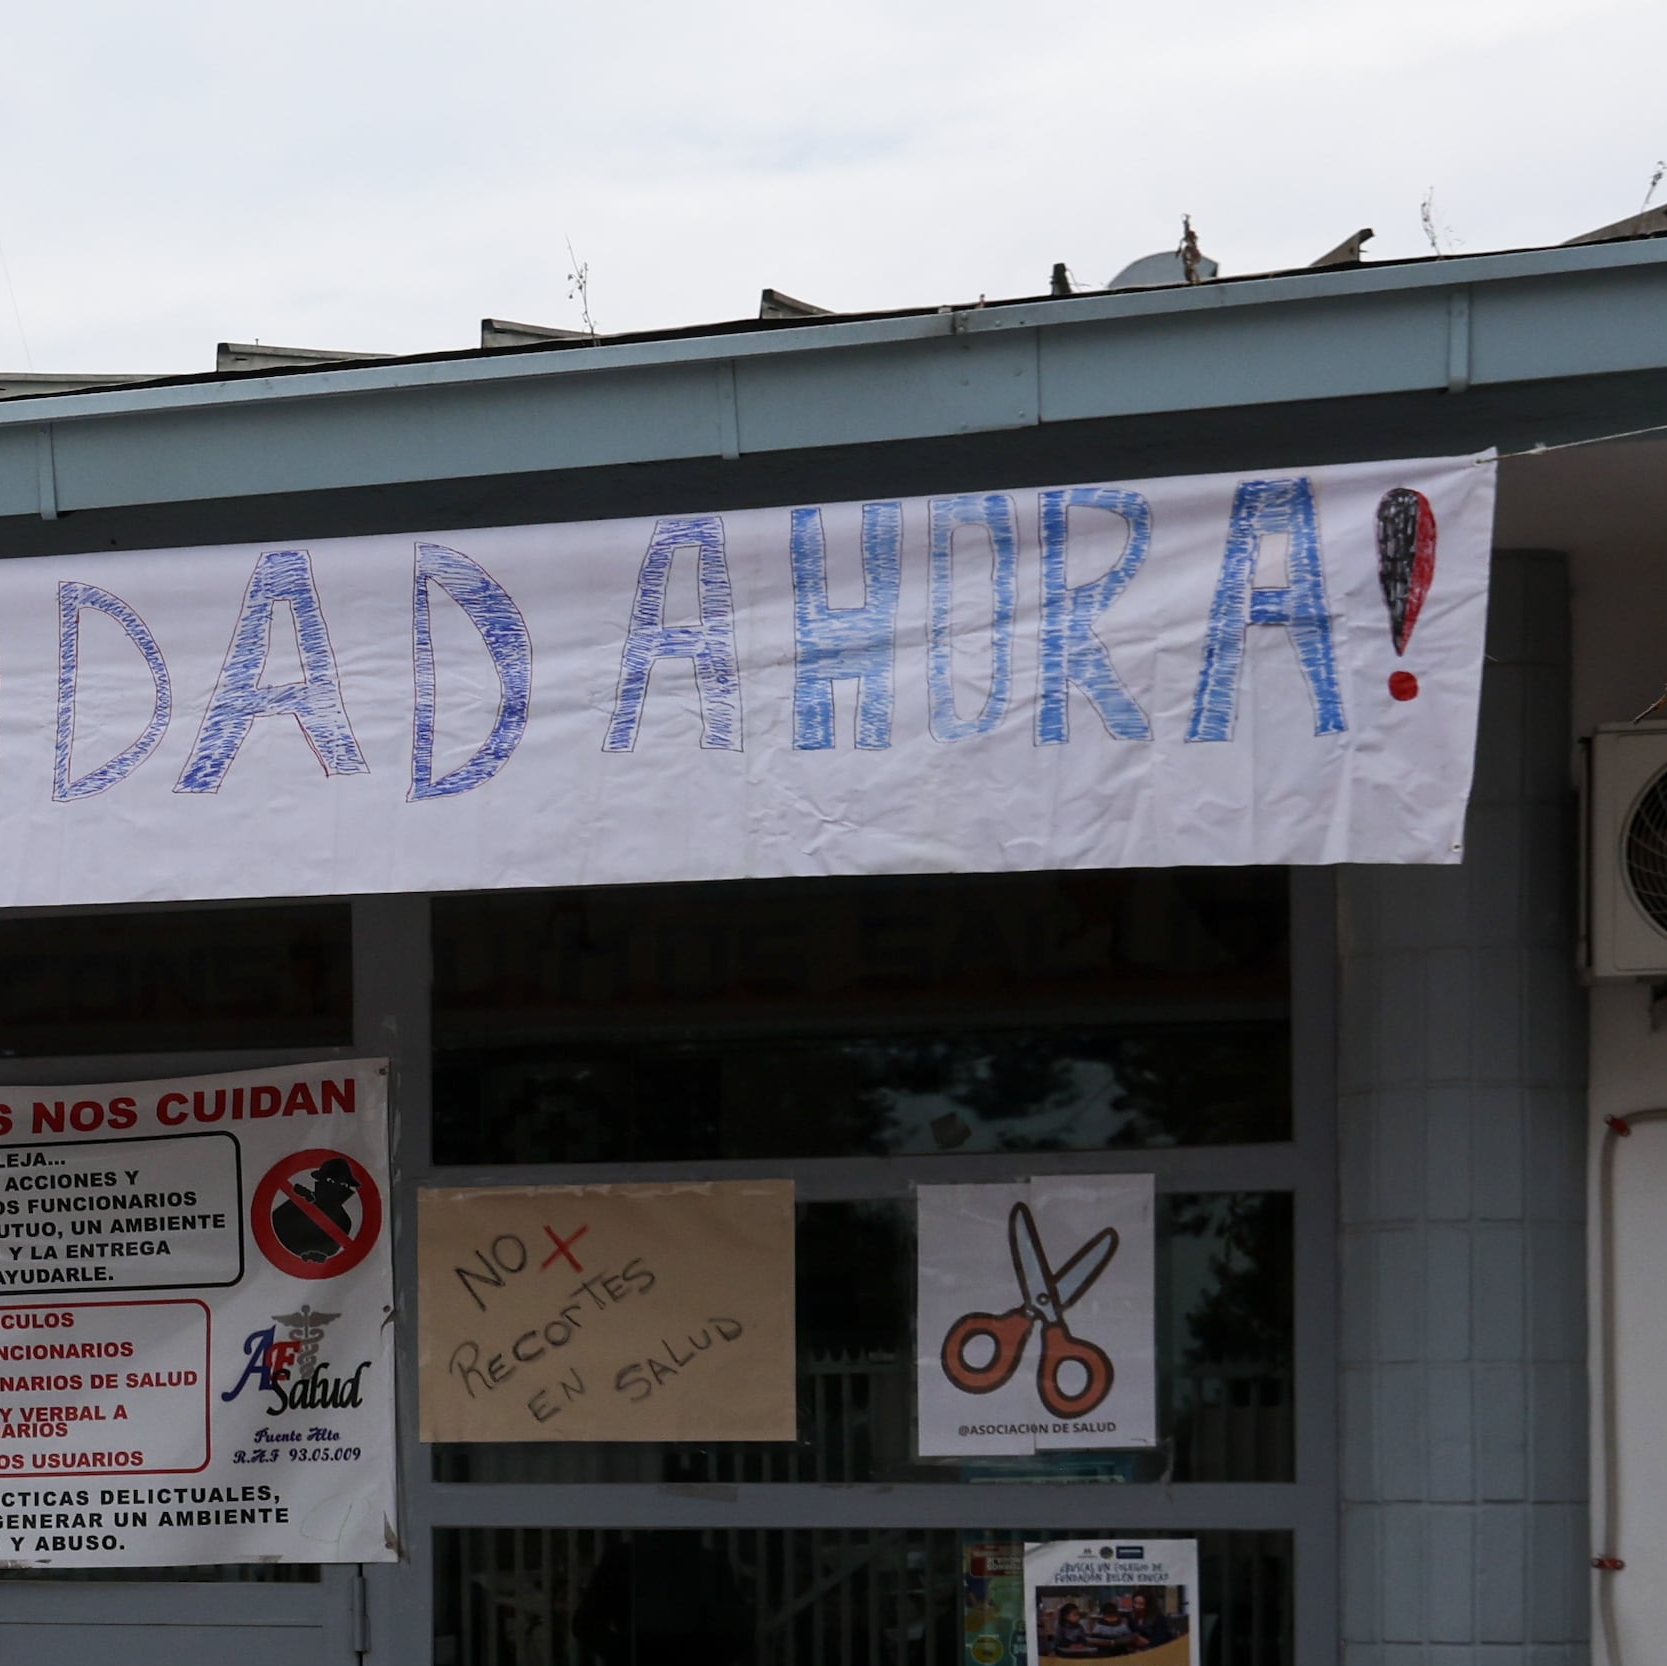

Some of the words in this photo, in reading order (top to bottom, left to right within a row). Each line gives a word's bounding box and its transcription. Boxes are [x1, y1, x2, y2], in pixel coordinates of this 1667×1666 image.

[31, 1097, 138, 1134] NOS
[156, 1078, 356, 1126] CUIDAN
[4, 1171, 117, 1192] ACCIONES
[124, 1170, 139, 1186] Y
[27, 1191, 197, 1214] FUNCIONARIOS
[70, 1219, 102, 1236] UN
[109, 1213, 226, 1234] AMBIENTE
[7, 1246, 24, 1261] Y
[30, 1245, 58, 1260] LA
[66, 1240, 171, 1259] ENTREGA
[454, 1233, 528, 1312] NO
[90, 1373, 119, 1389] DE
[126, 1370, 197, 1388] SALUD
[527, 1367, 586, 1423] EN
[614, 1317, 743, 1403] SALUD
[267, 1361, 373, 1416] Salud
[19, 1405, 106, 1423] VERBAL
[113, 1404, 128, 1420] A
[254, 1427, 303, 1444] Puente
[307, 1426, 341, 1443] Alto
[1053, 1423, 1069, 1434] DE
[1073, 1421, 1117, 1434] SALUD
[32, 1451, 143, 1469] USUARIOS
[288, 1447, 362, 1462] 93.05.009
[100, 1485, 280, 1506] DELICTUALES,
[114, 1511, 147, 1528] UN
[158, 1507, 289, 1527] AMBIENTE
[10, 1536, 25, 1552] Y
[35, 1534, 125, 1551] ABUSO.
